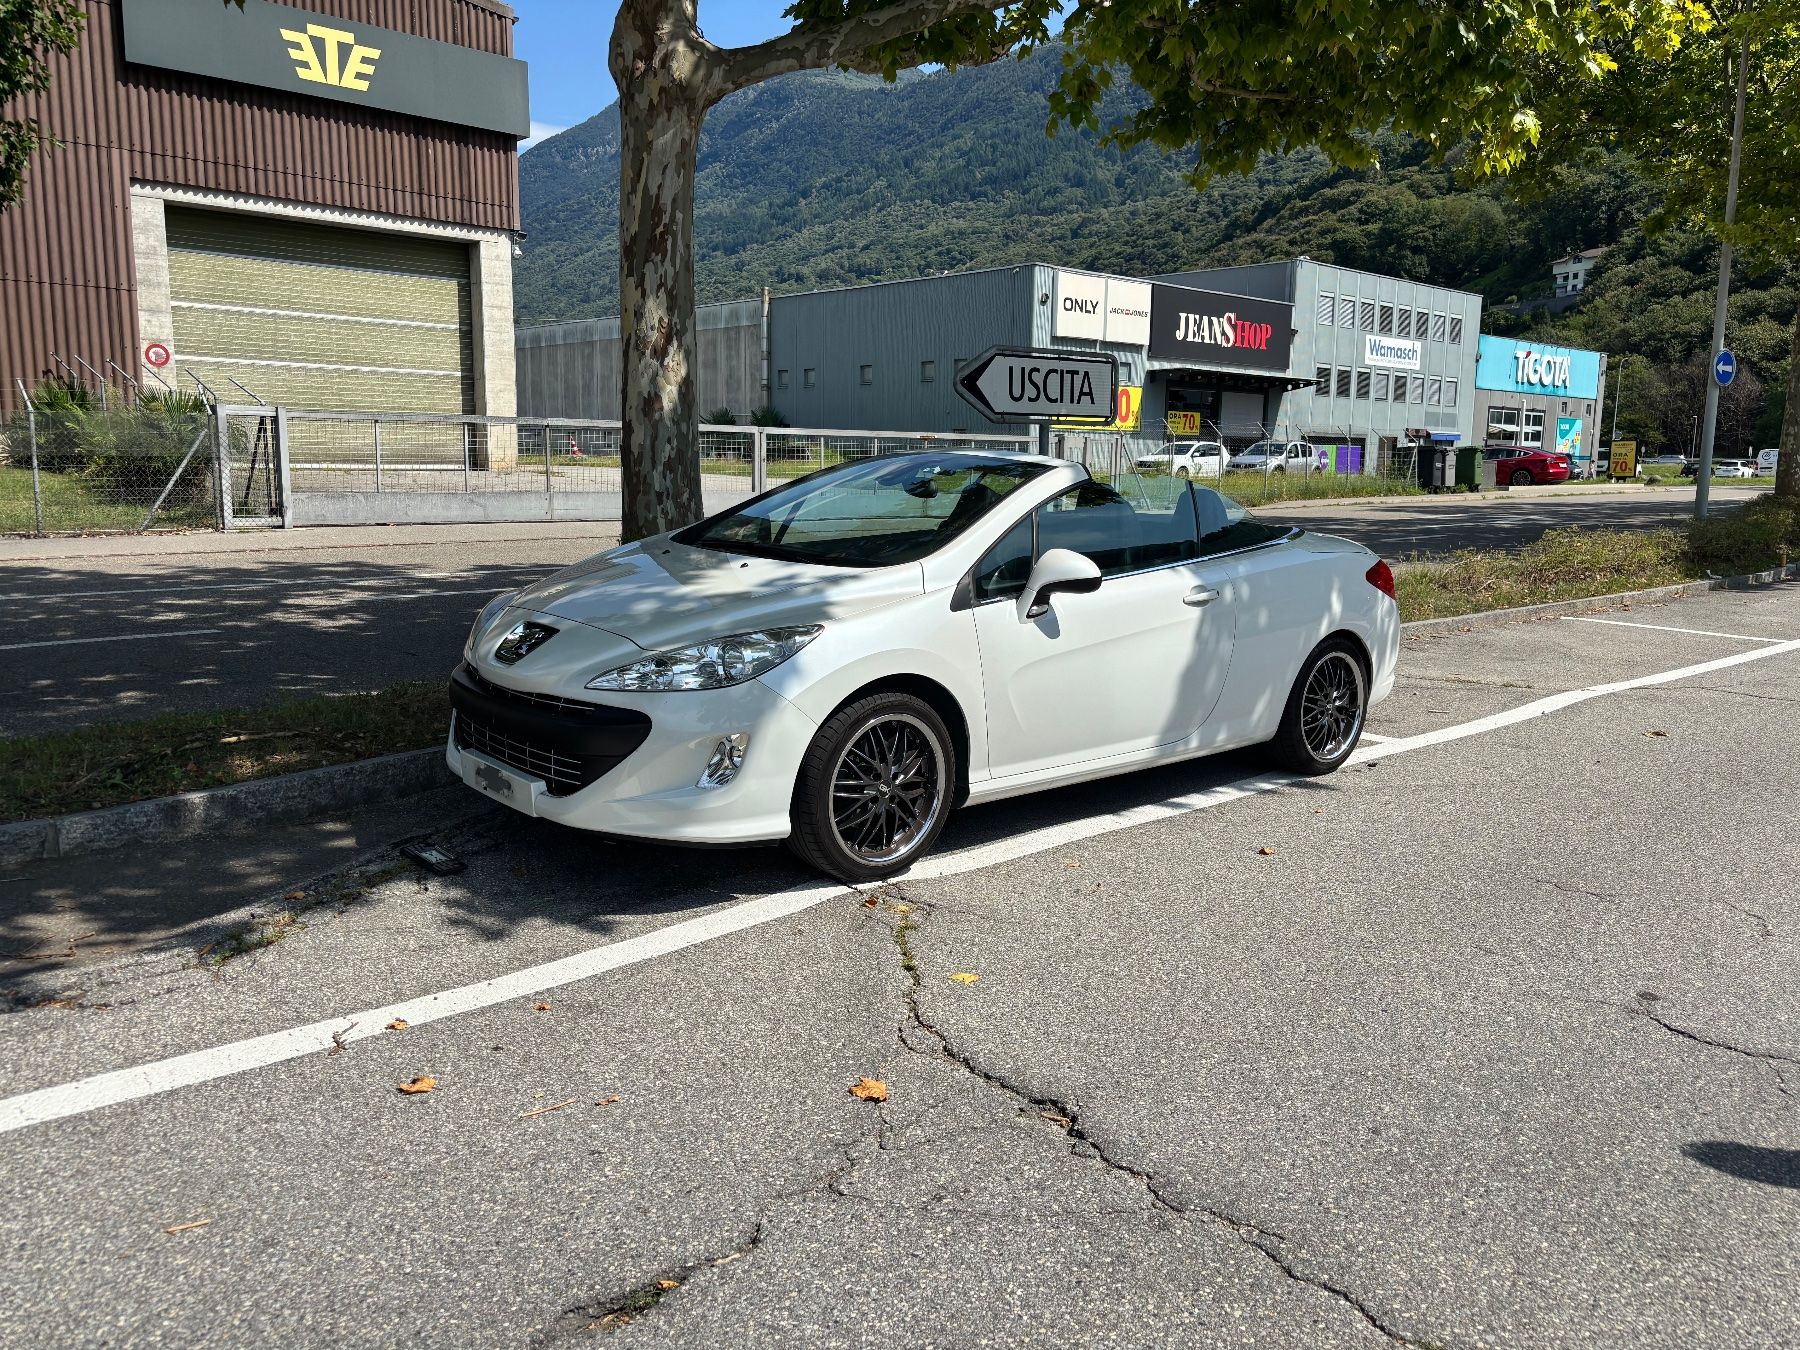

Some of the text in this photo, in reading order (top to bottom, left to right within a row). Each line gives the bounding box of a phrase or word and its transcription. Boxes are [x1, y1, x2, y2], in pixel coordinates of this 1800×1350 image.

[1063, 297, 1099, 315] ONLY
[1369, 338, 1418, 361] Wamasch
[1008, 366, 1095, 404] USCITA
[1117, 388, 1139, 423] 0%
